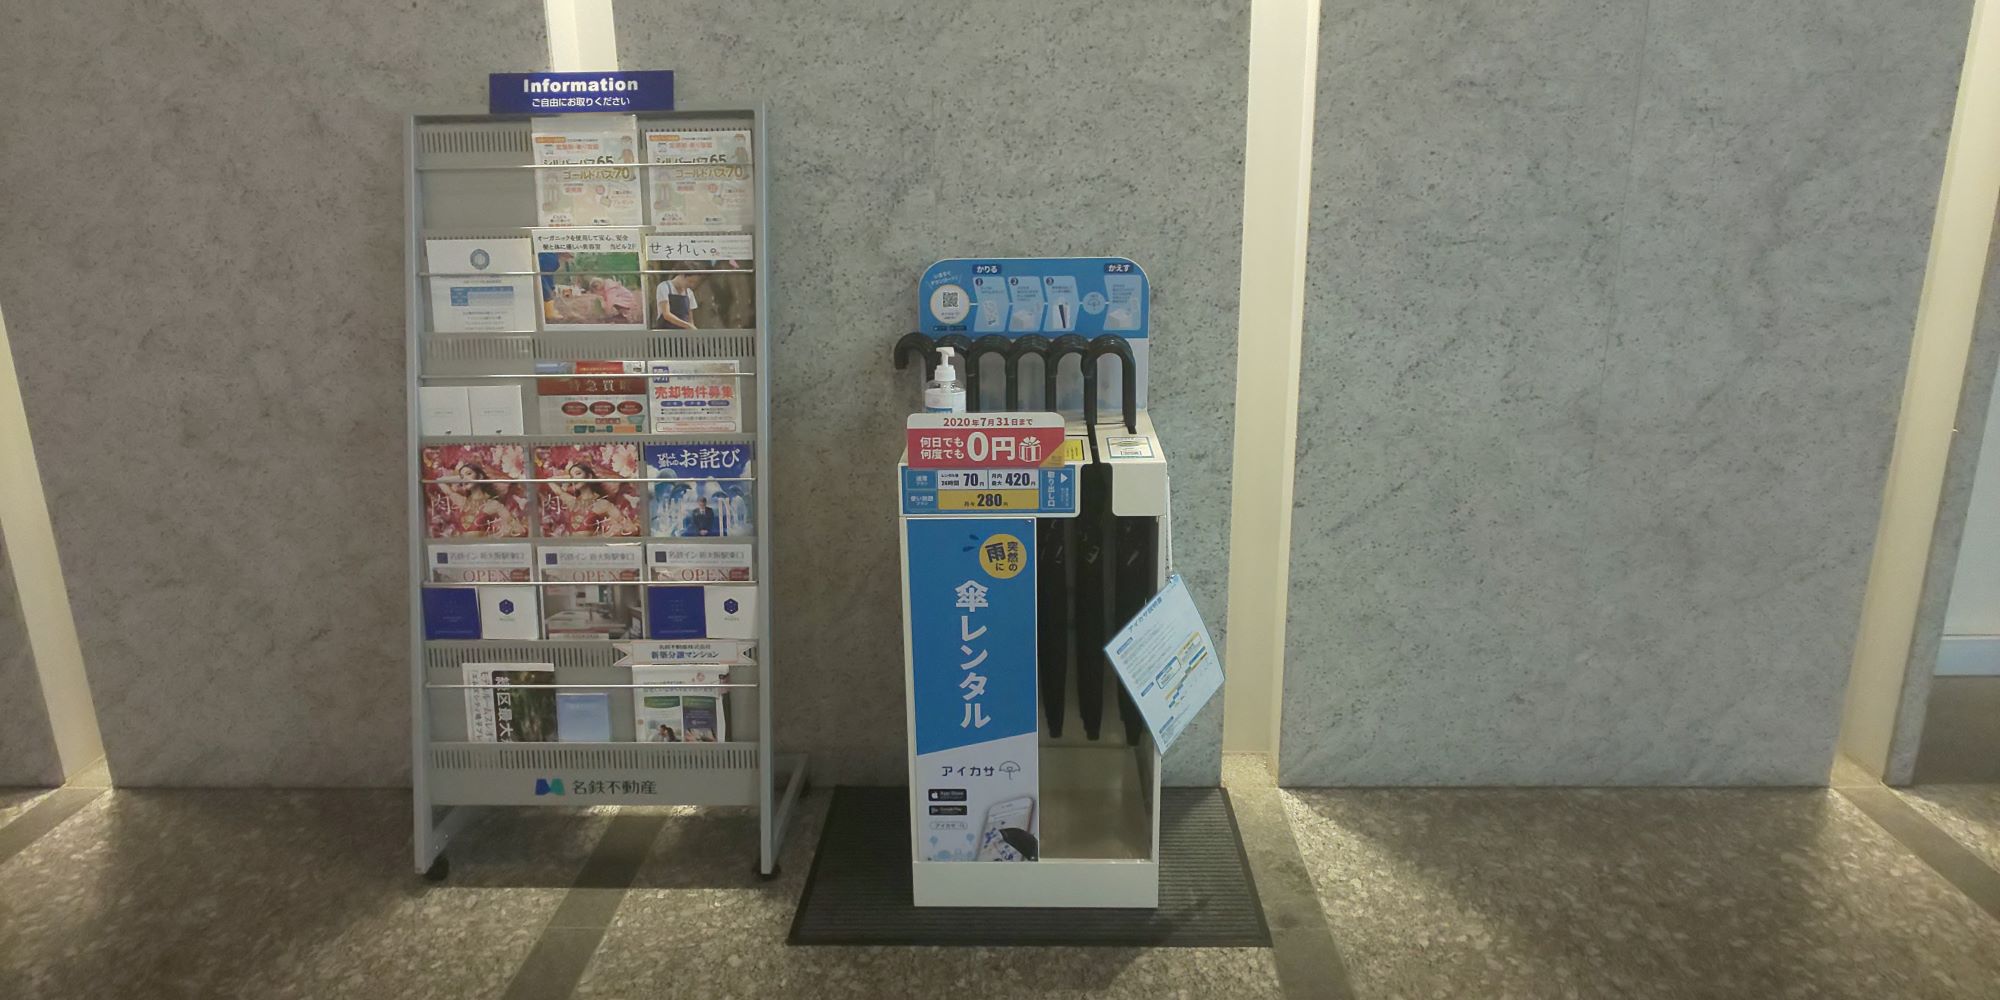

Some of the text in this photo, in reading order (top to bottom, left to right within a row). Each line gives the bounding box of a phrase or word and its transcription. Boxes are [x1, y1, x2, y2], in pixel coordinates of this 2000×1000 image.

[524, 78, 638, 92] Information
[532, 98, 630, 107] ご自由にお取りください
[976, 265, 998, 274] かりる
[1108, 264, 1131, 272] かえす
[655, 385, 734, 400] 売却物件募集
[943, 417, 1033, 427] 2020年7月31日まで
[920, 437, 965, 448] 何日でも
[966, 431, 1016, 462] 0円
[680, 448, 741, 469] お詫び
[920, 449, 965, 460] 何度でも
[963, 473, 985, 487] 70円
[1005, 472, 1036, 487] 420円
[1047, 471, 1056, 507] 取り出し口
[985, 542, 1006, 572] 雨に
[1007, 541, 1018, 572] 突然の
[463, 569, 511, 582] OPEN
[573, 570, 619, 582] OPEN
[682, 568, 730, 581] OPEN
[651, 650, 720, 660] 新築分譲マンション
[955, 580, 992, 729] 傘レンタル
[941, 766, 995, 777] アイカサ
[573, 780, 658, 795] 名鉄不動産
